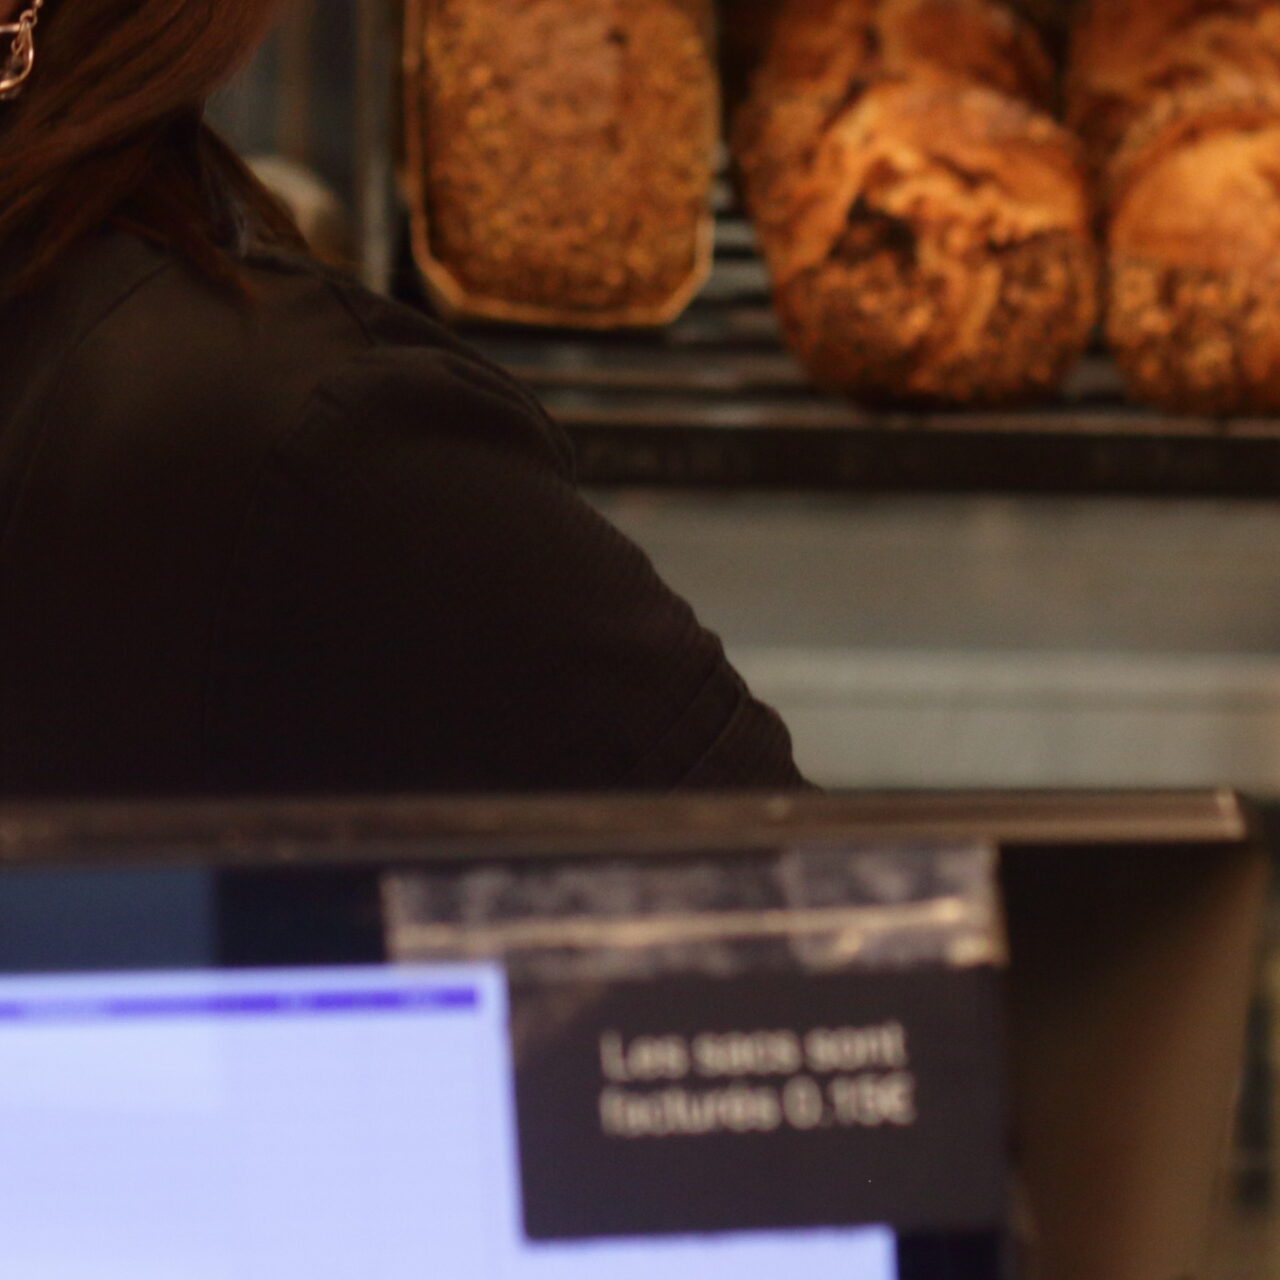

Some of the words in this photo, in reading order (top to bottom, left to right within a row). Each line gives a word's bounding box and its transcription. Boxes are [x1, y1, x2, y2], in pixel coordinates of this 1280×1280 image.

[600, 1028, 689, 1081] Les
[692, 1031, 802, 1077] sacs
[804, 1019, 908, 1072] sont
